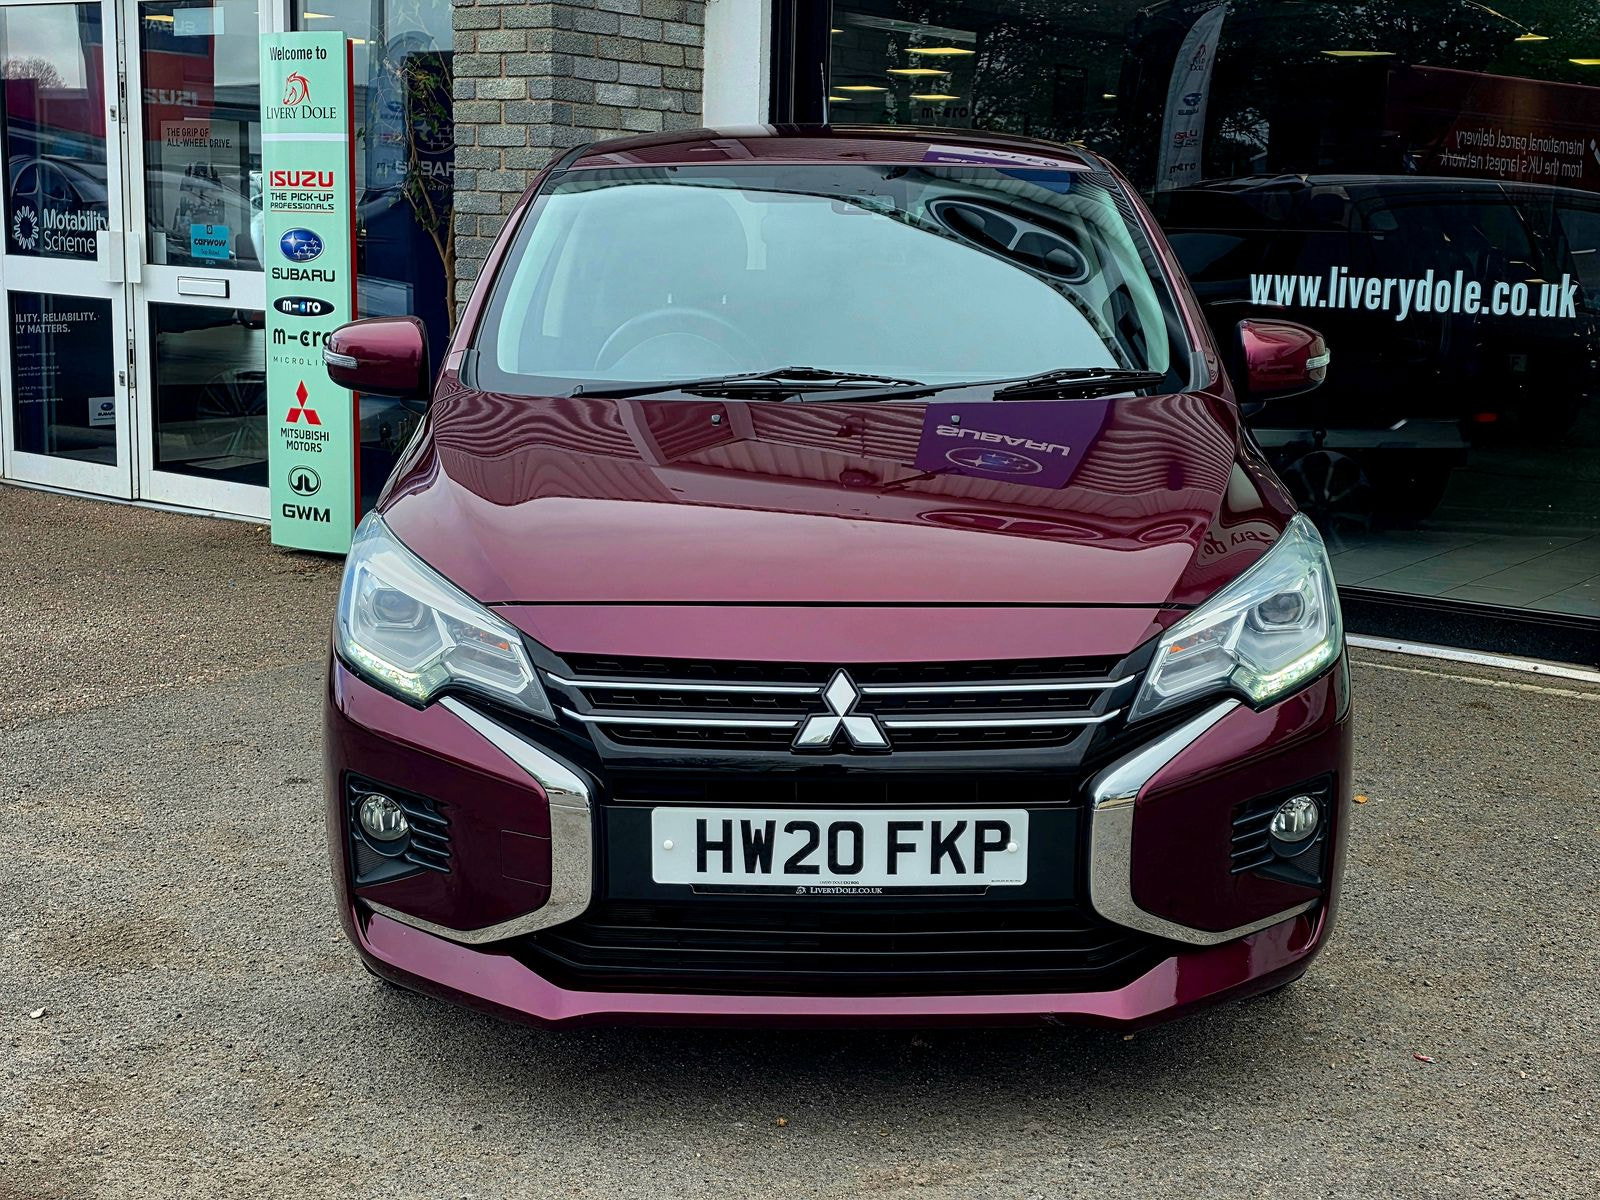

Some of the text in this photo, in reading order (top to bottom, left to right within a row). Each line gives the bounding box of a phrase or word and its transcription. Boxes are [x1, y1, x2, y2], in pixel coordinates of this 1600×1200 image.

[270, 46, 327, 60] Welcome to
[266, 105, 336, 119] LIVERY DOLE
[167, 127, 209, 137] THE GRIP OF
[167, 138, 233, 149] ALL-WHEEL DRIVE.
[395, 160, 454, 177] SBAR
[269, 170, 334, 188] ISUZU
[270, 192, 334, 202] THE PICK-UP
[270, 202, 335, 210] PROFESSIONALS
[43, 208, 110, 232] Motability
[44, 230, 96, 254] Scheme
[193, 237, 227, 247] carwow
[272, 267, 336, 282] SUBARU
[1250, 266, 1578, 322] www.liverydole.co.uk
[42, 312, 97, 322] RELIABILITY.
[27, 323, 71, 334] MATTERS.
[280, 427, 330, 441] MITSUBISHI
[286, 440, 323, 453] MOTORS
[282, 503, 331, 523] GWM
[696, 818, 1012, 875] HW20 FKP
